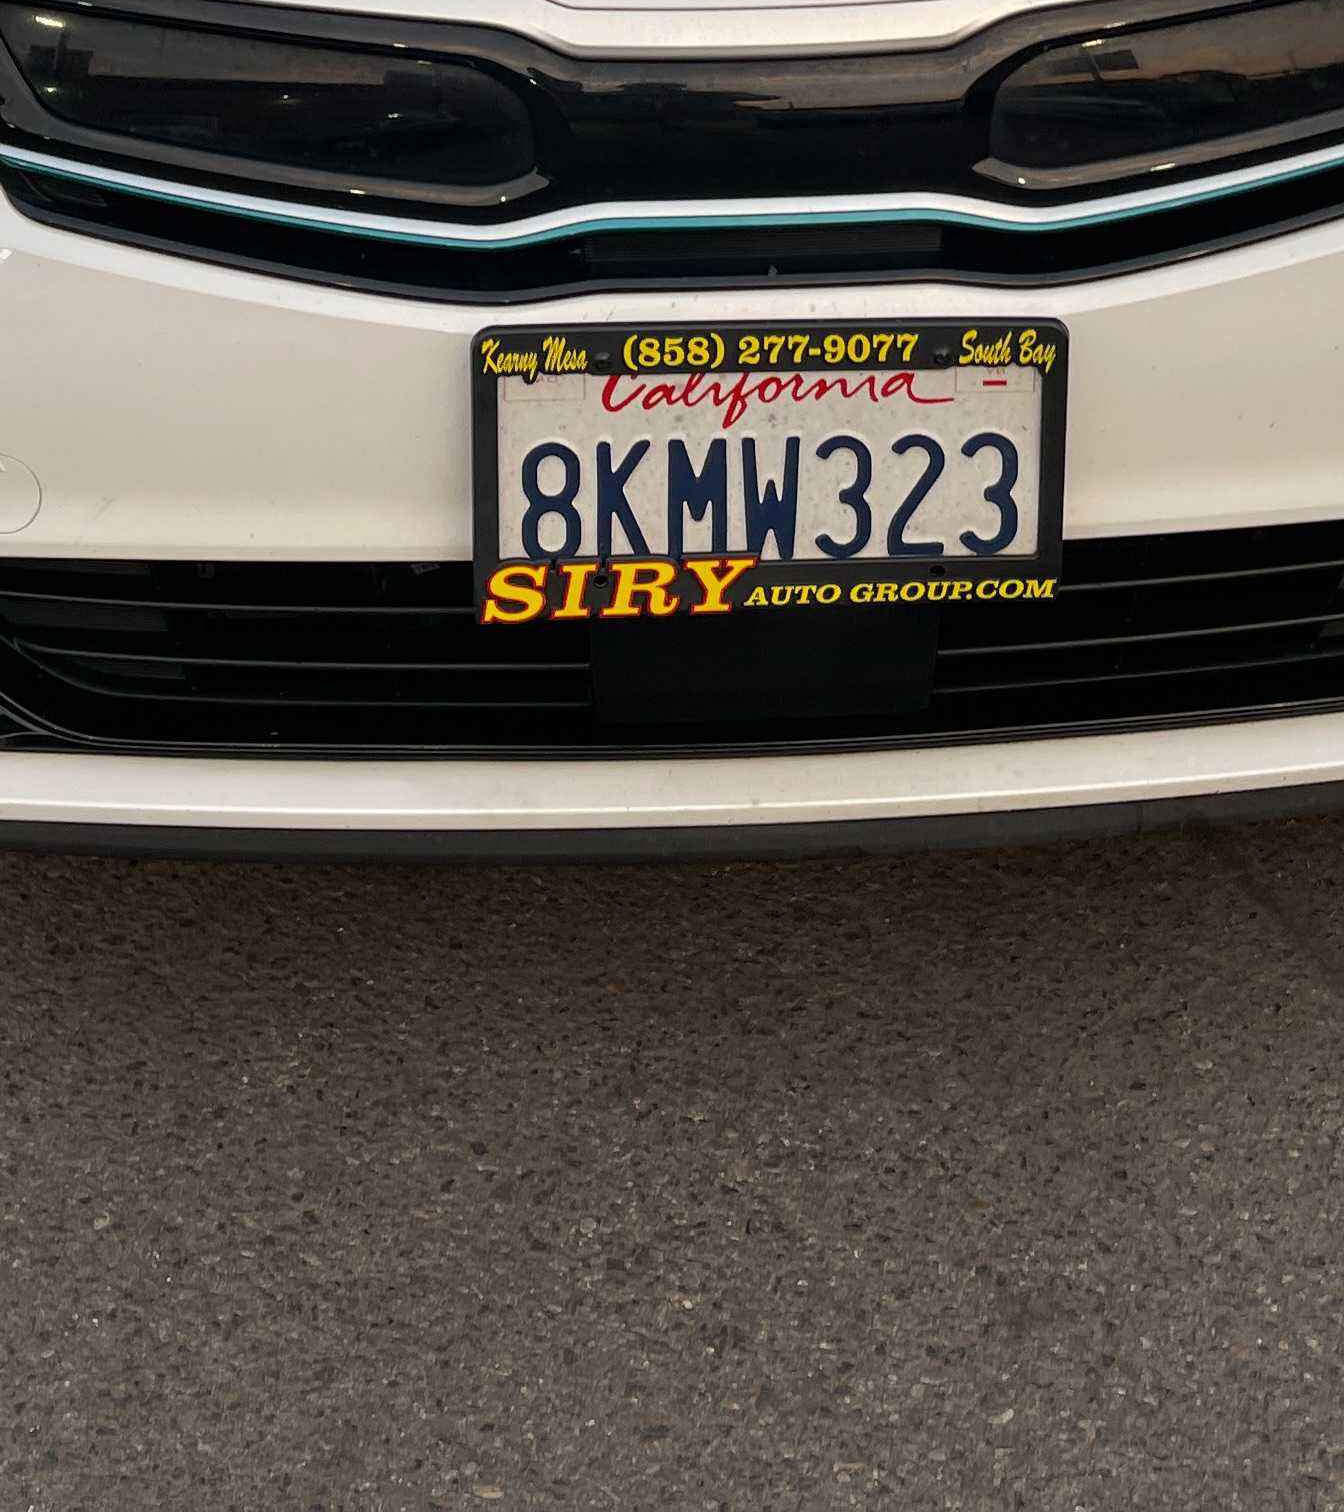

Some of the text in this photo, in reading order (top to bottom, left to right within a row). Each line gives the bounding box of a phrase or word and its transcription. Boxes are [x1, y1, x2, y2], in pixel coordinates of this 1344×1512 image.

[482, 335, 588, 380] Kearny Mesa
[623, 332, 919, 371] (858) 277-9077
[958, 328, 1057, 375] South Bay
[601, 373, 955, 429] California
[520, 431, 1020, 561] 8KMW323
[481, 557, 1057, 624] SIRY AUTO GROUP.COM
